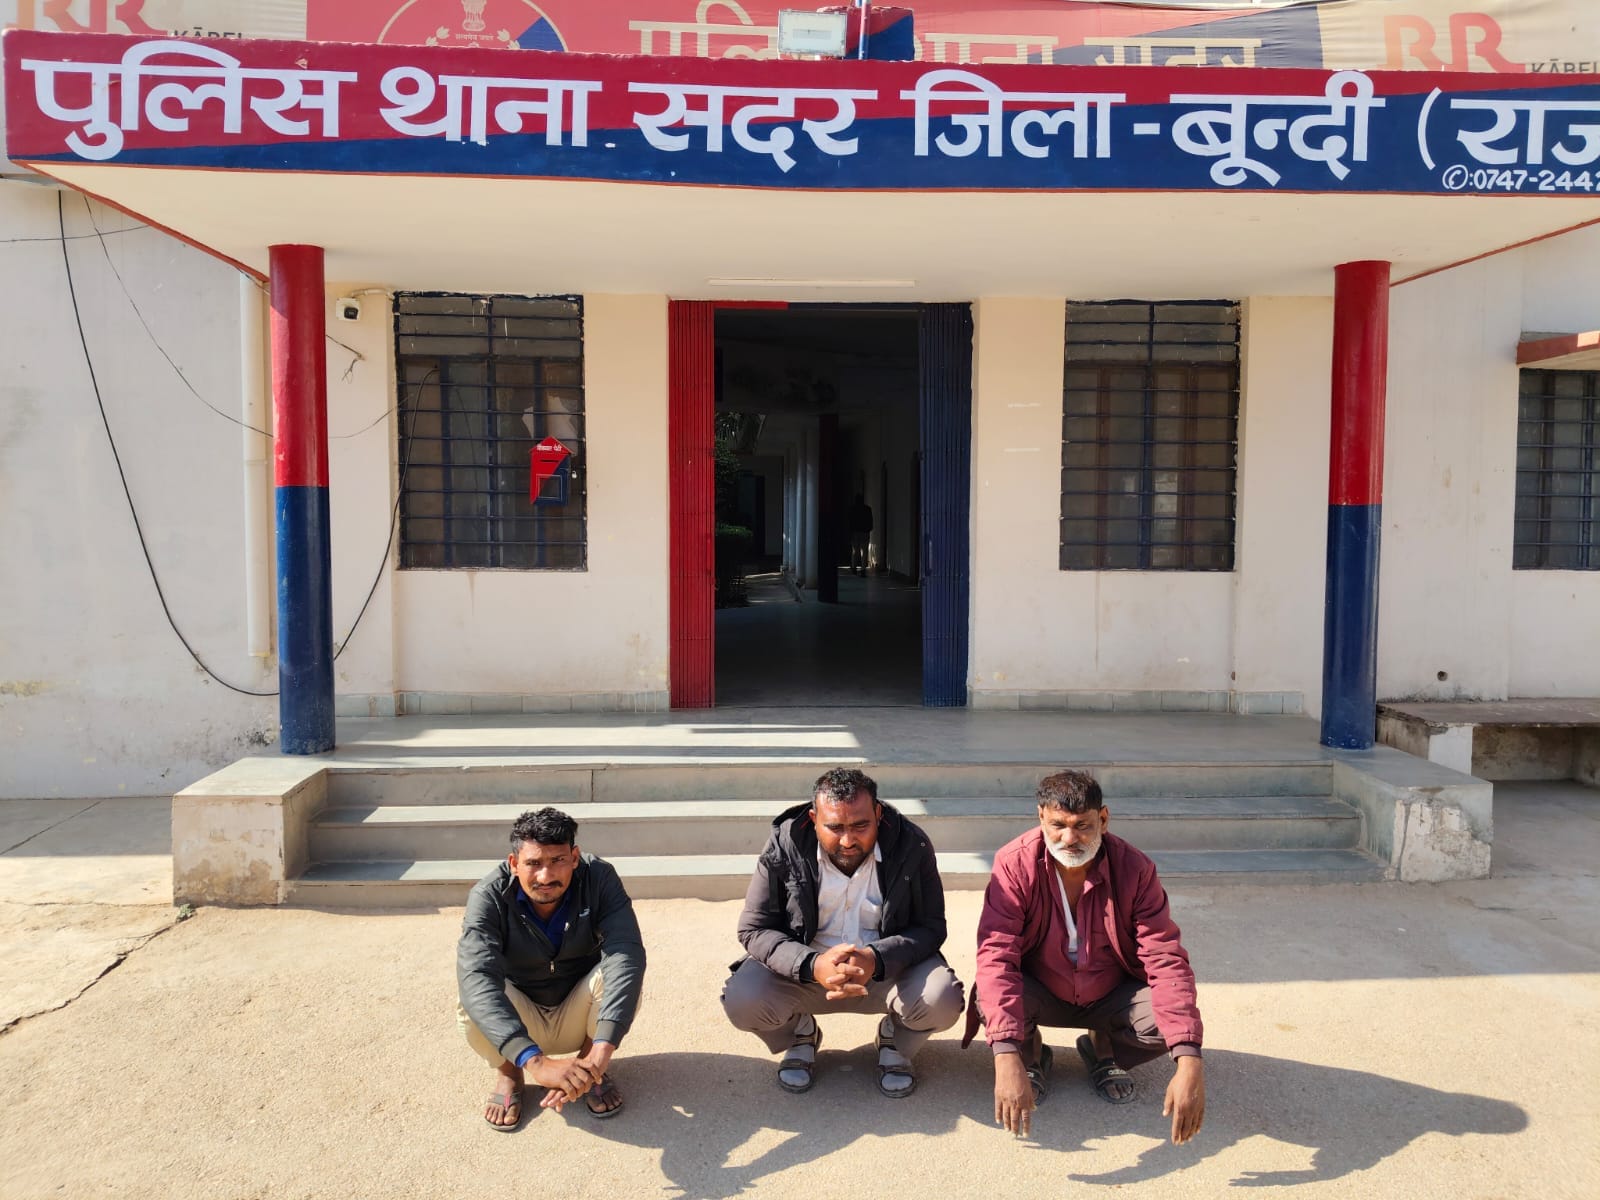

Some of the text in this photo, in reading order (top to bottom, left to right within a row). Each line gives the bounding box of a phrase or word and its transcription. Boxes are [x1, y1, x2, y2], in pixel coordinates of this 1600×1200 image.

[1377, 13, 1526, 73] RR
[21, 40, 358, 161] पुलिस
[380, 66, 603, 147] थाना
[628, 82, 878, 173] सदर
